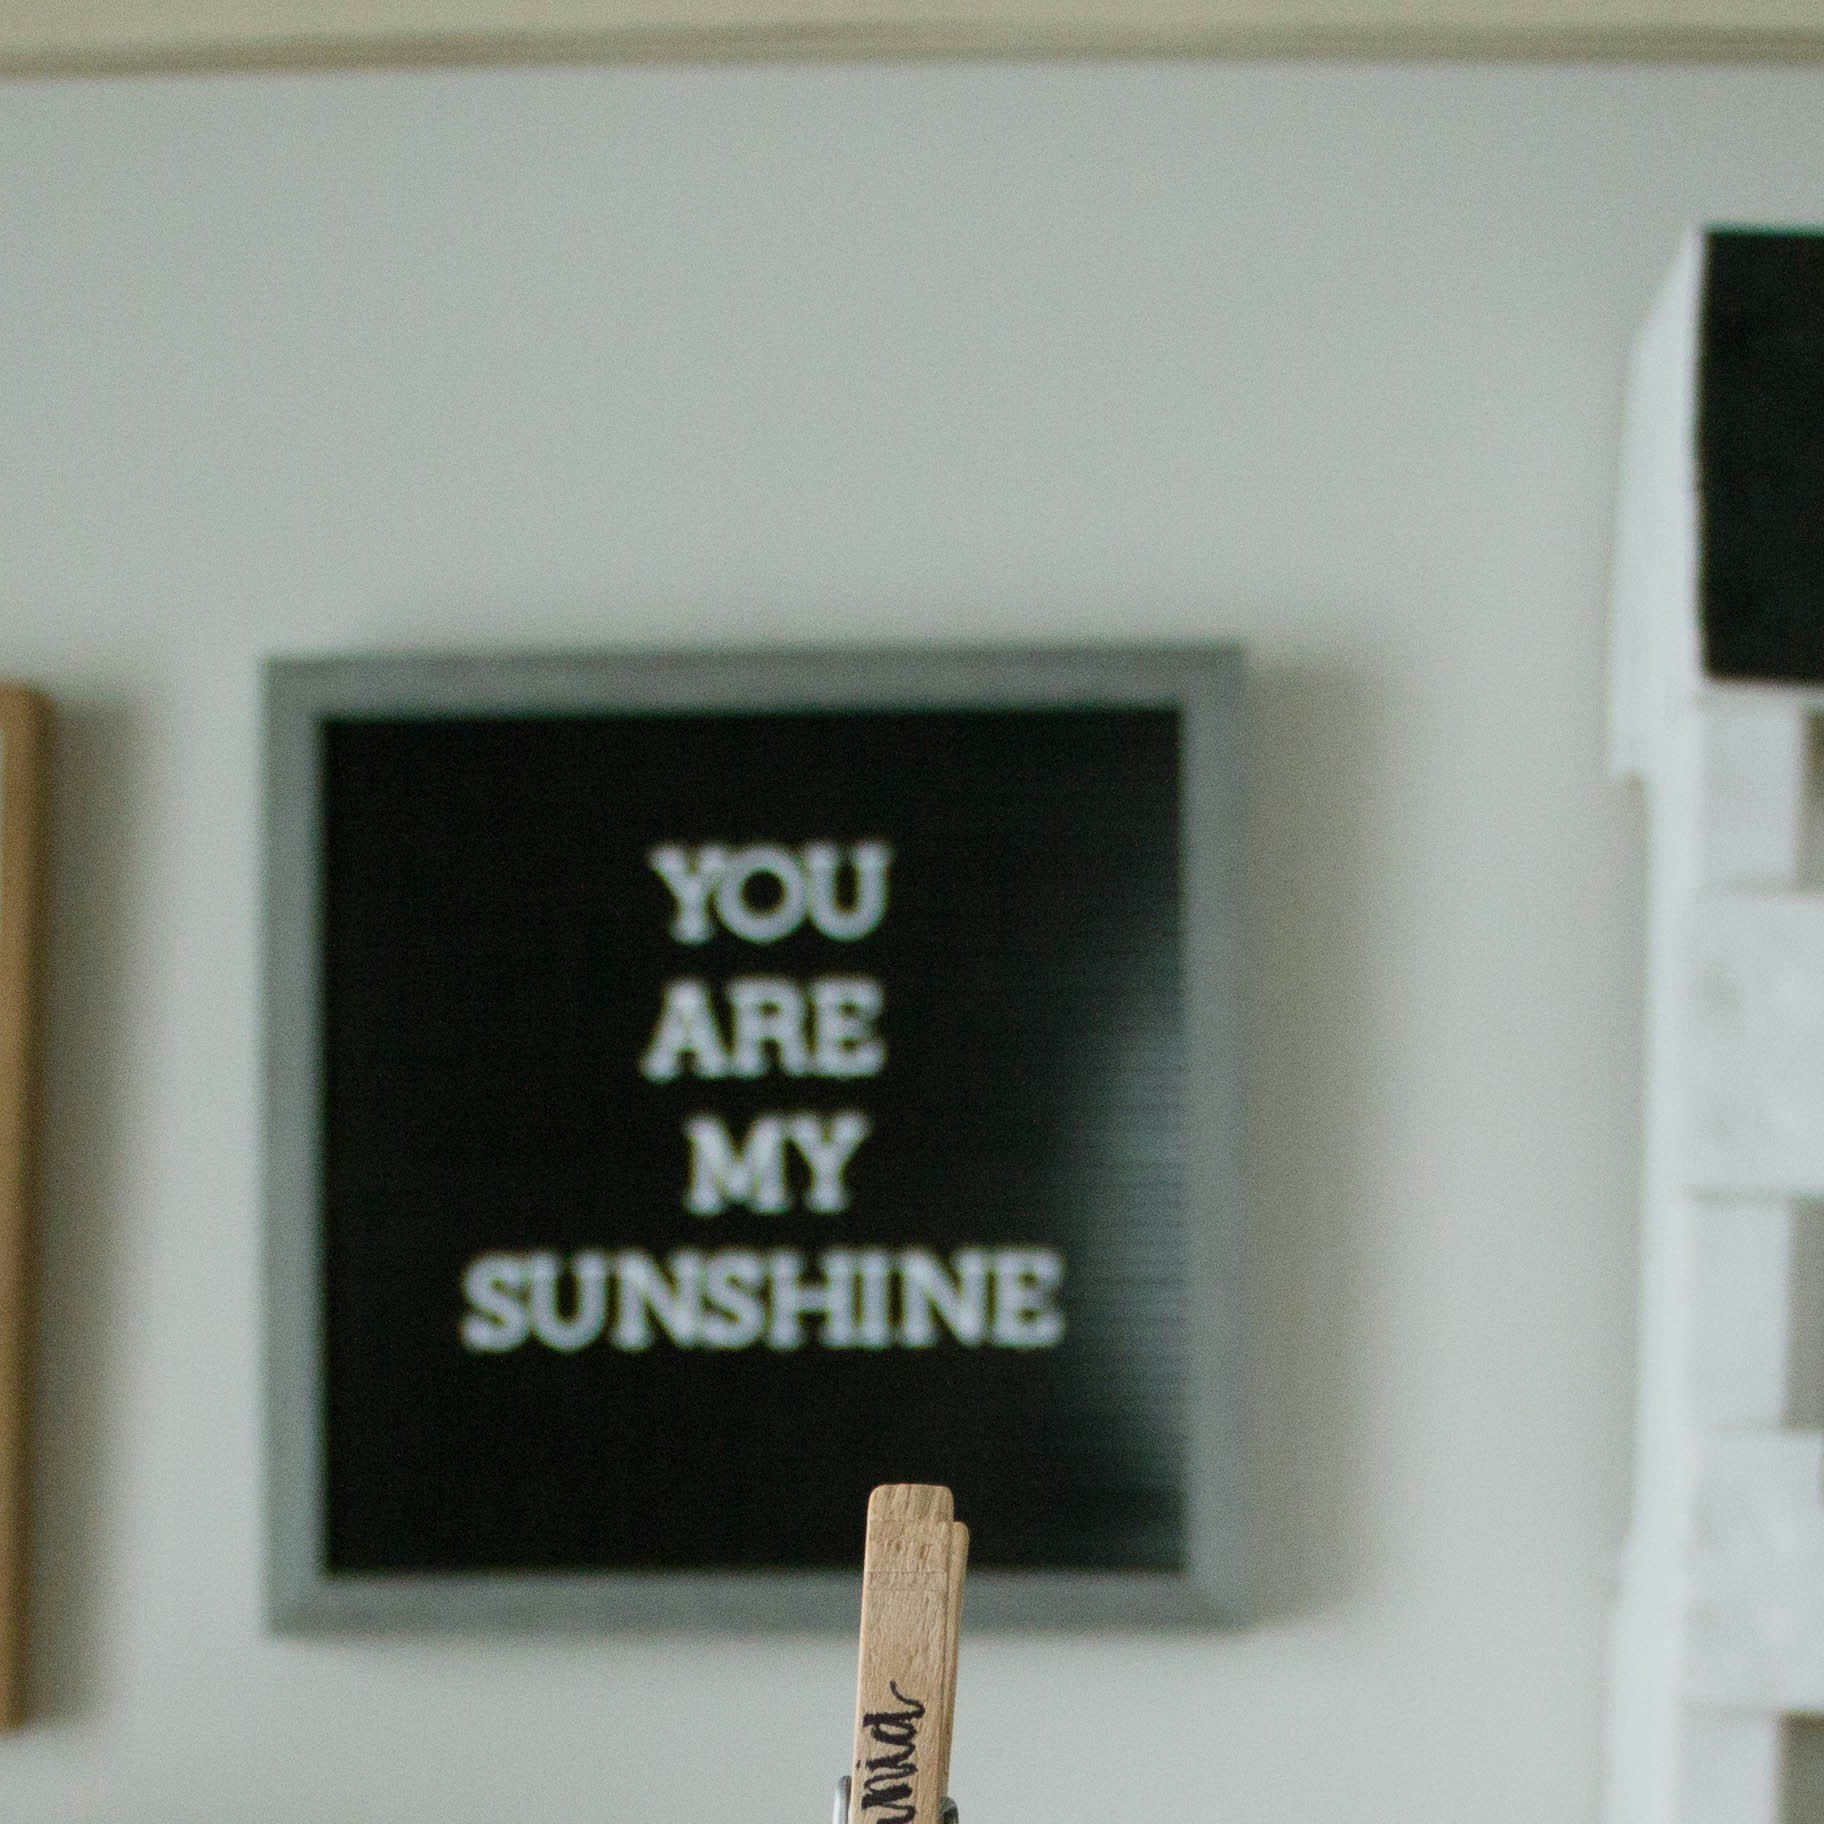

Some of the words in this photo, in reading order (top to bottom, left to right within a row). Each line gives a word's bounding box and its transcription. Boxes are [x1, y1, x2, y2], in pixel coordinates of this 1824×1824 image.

[649, 840, 892, 946] YOU
[639, 975, 888, 1083] ARE
[684, 1110, 870, 1217] MY
[458, 1244, 1068, 1353] SUNSHINE
